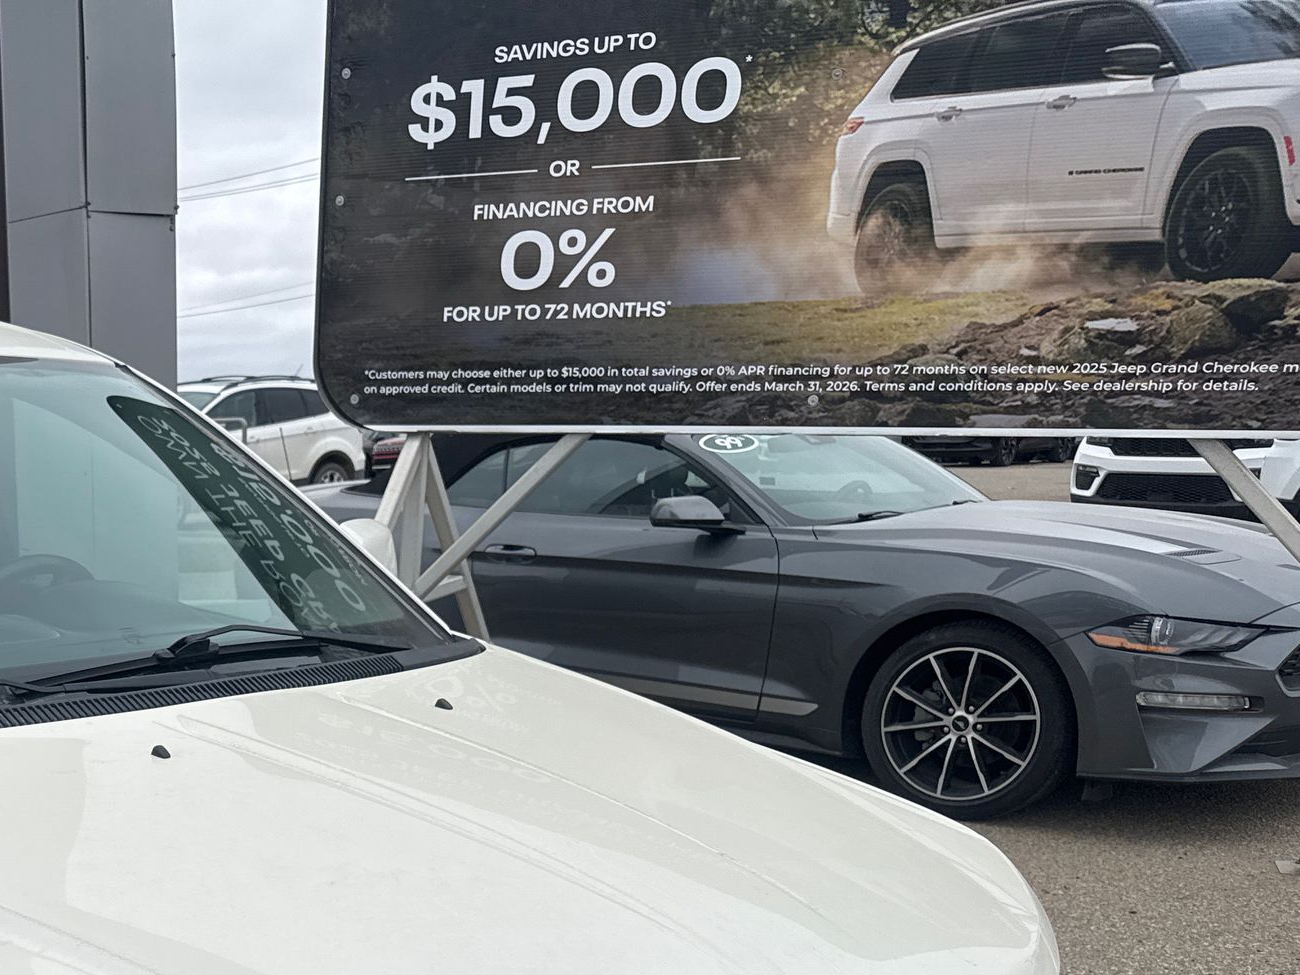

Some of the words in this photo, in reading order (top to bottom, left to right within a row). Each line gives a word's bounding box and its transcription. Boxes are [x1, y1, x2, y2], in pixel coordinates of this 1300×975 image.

[494, 38, 590, 63] SAVINGS
[594, 34, 624, 54] UP
[628, 31, 657, 51] TO
[548, 159, 581, 178] OR
[473, 198, 589, 222] FINANCING
[592, 194, 656, 216] FROM
[500, 226, 617, 292] 0%
[442, 305, 482, 323] FOR
[483, 304, 512, 322] UP
[514, 304, 541, 321] TO
[544, 303, 569, 321] 72
[426, 371, 451, 380] may
[451, 368, 491, 379] choose
[493, 368, 528, 378] either
[529, 369, 545, 380] up
[547, 368, 559, 377] to
[561, 366, 605, 379] $15,000
[607, 367, 619, 377] in
[621, 366, 650, 377] total
[651, 367, 698, 379] savings
[700, 367, 714, 376] or
[716, 365, 736, 376] 0%
[738, 365, 766, 376] APR
[768, 364, 830, 377] financing
[833, 364, 853, 375] for
[855, 366, 873, 377] up
[876, 365, 891, 375] to
[893, 364, 910, 375] 72
[912, 364, 966, 375] months
[970, 365, 988, 375] on
[990, 363, 1034, 375] select
[1037, 364, 1070, 375] new
[1072, 362, 1108, 374] 2025
[1109, 362, 1147, 376] Jeep
[1150, 361, 1199, 374] Grand
[1202, 361, 1279, 374] Cherokee
[364, 386, 377, 394] on
[379, 383, 429, 395] approved
[430, 383, 465, 394] credit.
[466, 383, 508, 393] Certain
[510, 383, 552, 393] models
[554, 384, 568, 393] or
[569, 382, 595, 393] trim
[596, 383, 624, 394] may
[625, 382, 646, 392] not
[648, 381, 693, 394] qualify.
[695, 381, 727, 392] Offer
[730, 381, 761, 392] ends
[764, 381, 804, 392] March
[807, 381, 822, 393] 31,
[825, 381, 861, 392] 2026.
[864, 381, 905, 391] Terms
[908, 381, 936, 391] and
[938, 380, 1013, 392] conditions
[1016, 380, 1059, 393] apply.
[1062, 380, 1090, 391] See
[1093, 379, 1173, 393] dealership
[1176, 380, 1198, 391] for
[1202, 380, 1259, 391] details.
